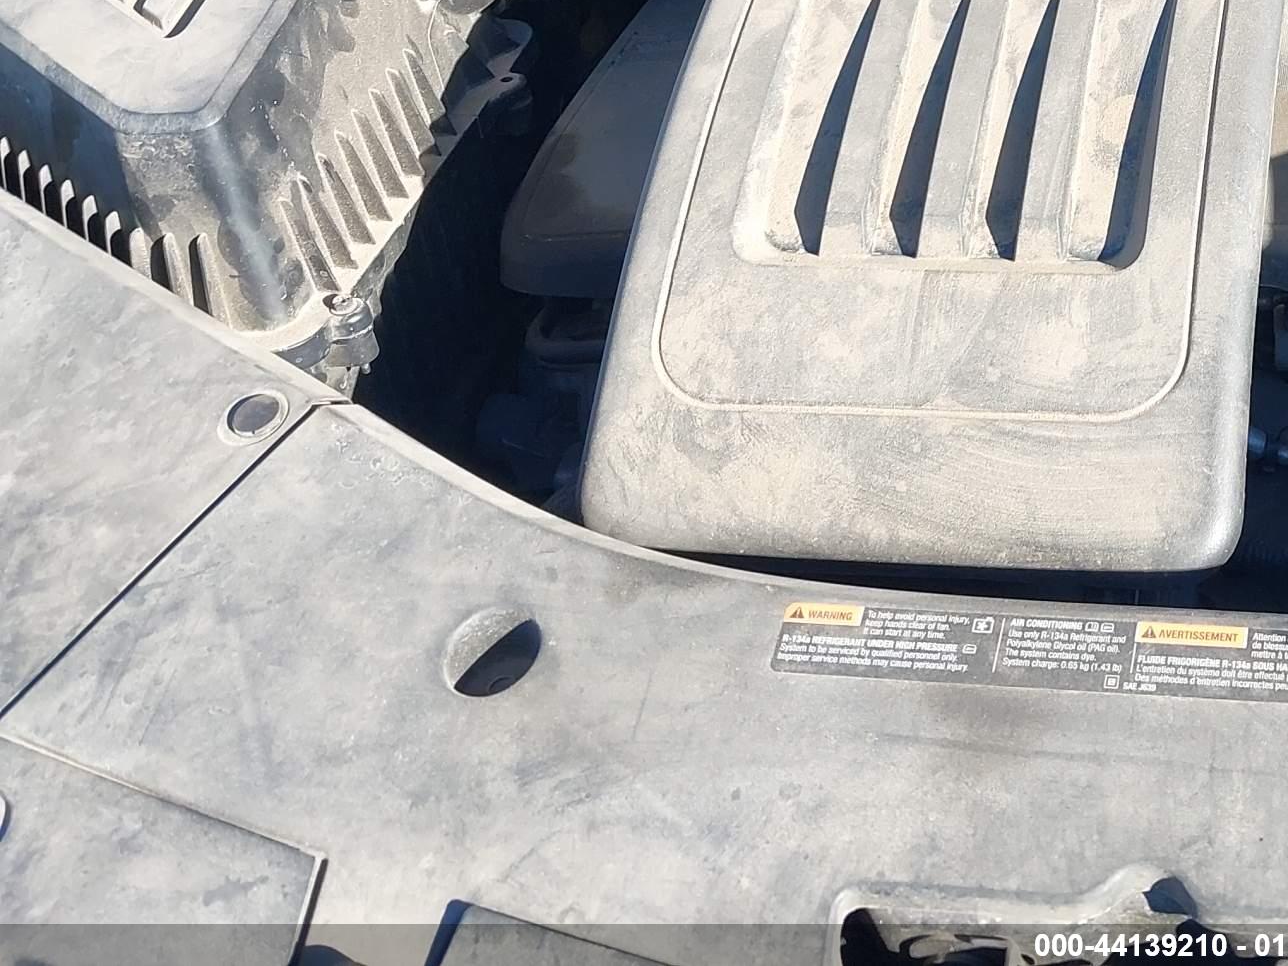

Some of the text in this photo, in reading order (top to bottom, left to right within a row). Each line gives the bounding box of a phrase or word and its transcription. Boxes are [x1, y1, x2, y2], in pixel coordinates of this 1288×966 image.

[808, 610, 853, 620] WARNING
[868, 610, 876, 618] To
[877, 611, 894, 620] help
[895, 613, 915, 621] avoid
[916, 614, 947, 623] personal
[865, 618, 883, 628] keep
[885, 620, 907, 628] hands
[908, 621, 927, 629] clear
[928, 622, 936, 630] of
[1010, 618, 1083, 630] AIR CONDITIONING
[870, 628, 883, 636] can
[911, 630, 926, 640] any
[927, 631, 946, 639] time.
[1008, 629, 1126, 644] Use only R-134a Refrigerant and
[1159, 629, 1239, 642] AVERTISSEMENT
[1252, 633, 1286, 642] Attention
[782, 634, 959, 652] R-134a REFRIGERANT UNDER HIGH PRESSURE
[1006, 638, 1052, 650] Polyalkylene
[1053, 641, 1076, 651] Glycol
[1077, 642, 1087, 651] oil
[1088, 643, 1105, 652] (PAG
[1252, 641, 1262, 649] de
[780, 642, 807, 652] System
[808, 645, 816, 653] to
[817, 645, 827, 653] be
[828, 647, 859, 656] serviced
[860, 648, 870, 658] by
[871, 649, 903, 659] qualified
[903, 651, 941, 660] personnel
[1005, 648, 1096, 662] The system contains dye.
[1251, 650, 1276, 658] mettre
[777, 652, 811, 662] Improper
[811, 655, 838, 663] service
[839, 656, 871, 665] methods
[872, 659, 889, 668] may
[890, 660, 912, 668] cause
[913, 661, 946, 670] personal
[1002, 657, 1122, 674] System charge: 0.65 kg (1.43 lb)
[1137, 655, 1167, 665] FLUIDE
[1167, 655, 1220, 667] FRIGORIGÈNE
[1222, 659, 1251, 670] R-134a
[1252, 661, 1275, 671] SOUS
[1177, 666, 1187, 674] du
[1188, 667, 1220, 678] système
[1222, 669, 1236, 678] doit
[1237, 669, 1252, 679] être
[1254, 671, 1285, 681] effectué
[1122, 682, 1137, 690] SAE
[1135, 673, 1150, 682] Des
[1151, 674, 1188, 685] méthodes
[1232, 679, 1274, 690] incorrectes
